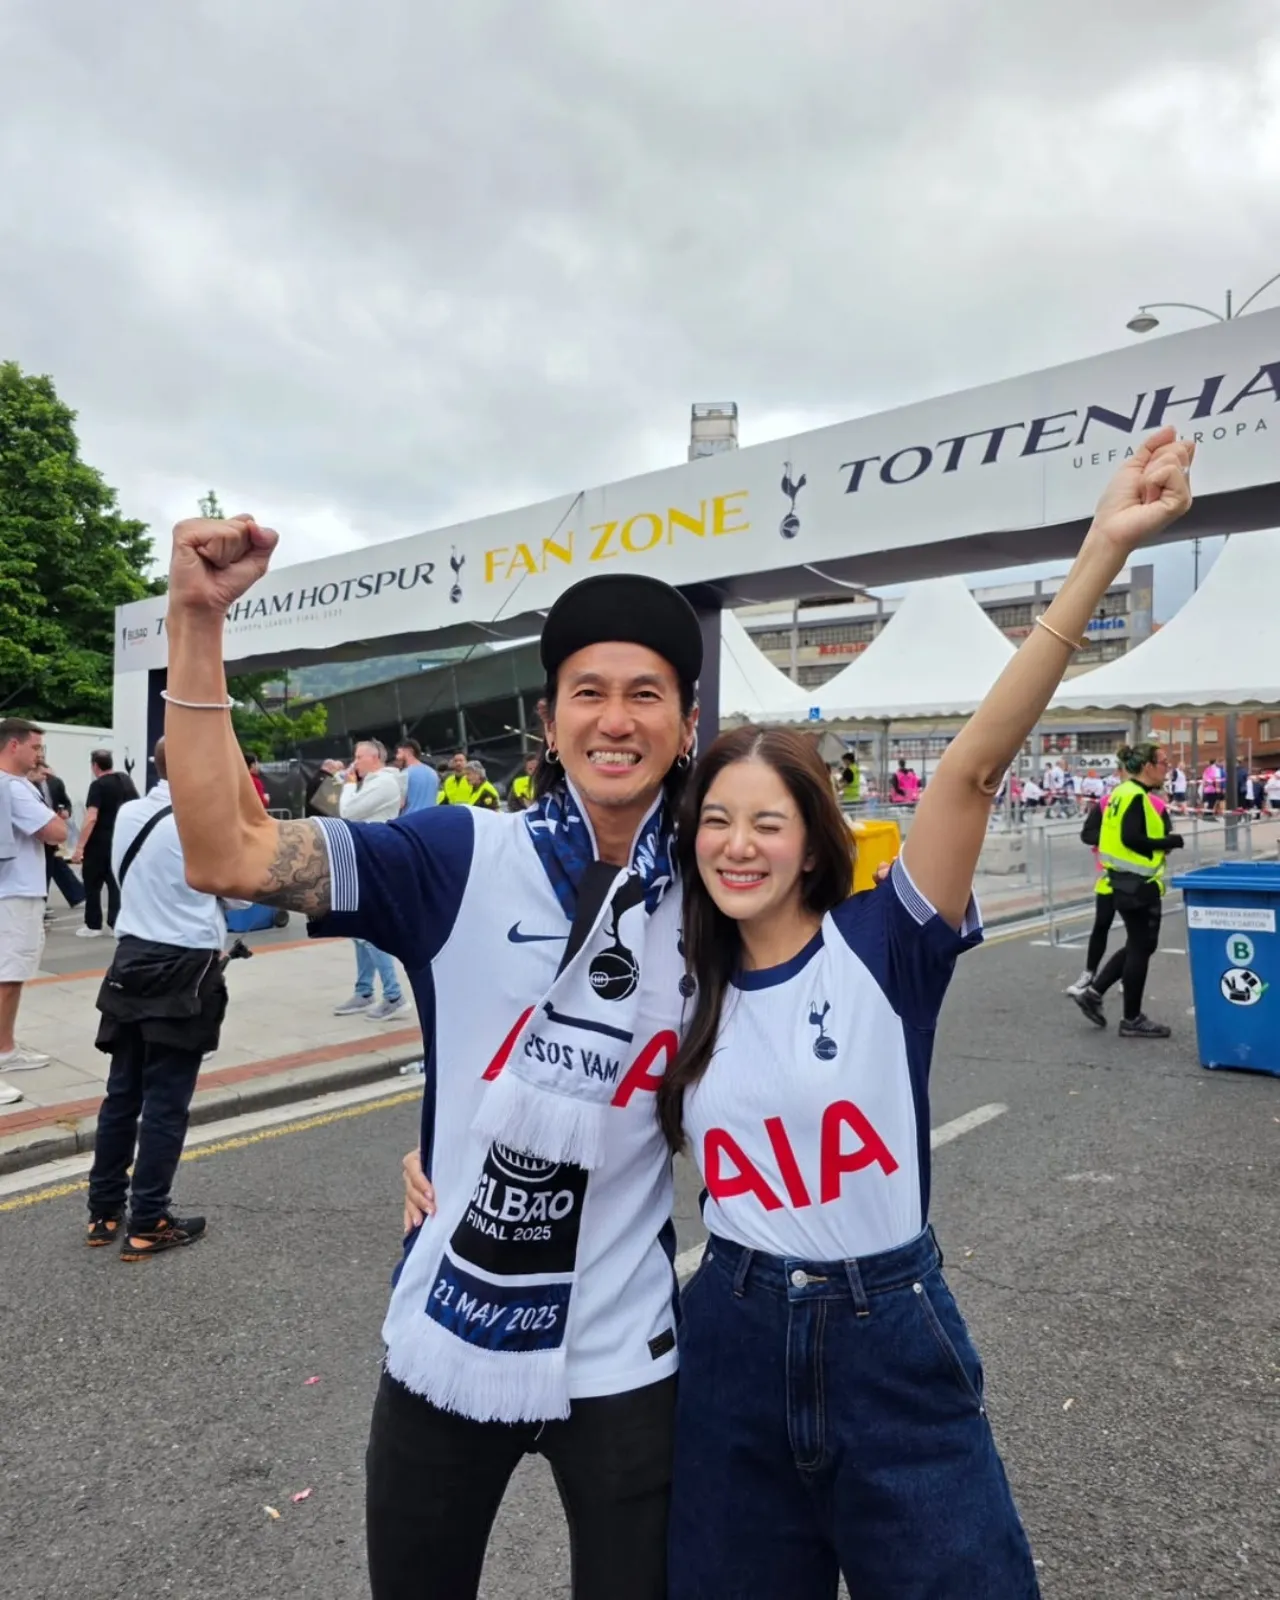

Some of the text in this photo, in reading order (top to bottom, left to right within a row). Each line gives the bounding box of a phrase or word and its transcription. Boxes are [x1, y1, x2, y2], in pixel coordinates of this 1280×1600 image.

[838, 360, 1280, 494] TOTTENHA
[1073, 418, 1268, 469] UEFA ROPA
[484, 490, 750, 583] FAN ZONE
[298, 562, 435, 610] HOTSPUR
[1233, 941, 1250, 960] B
[704, 1099, 899, 1212] AIA
[466, 1209, 552, 1241] FINAL 2025
[433, 1279, 560, 1331] 21 MAY 2025
